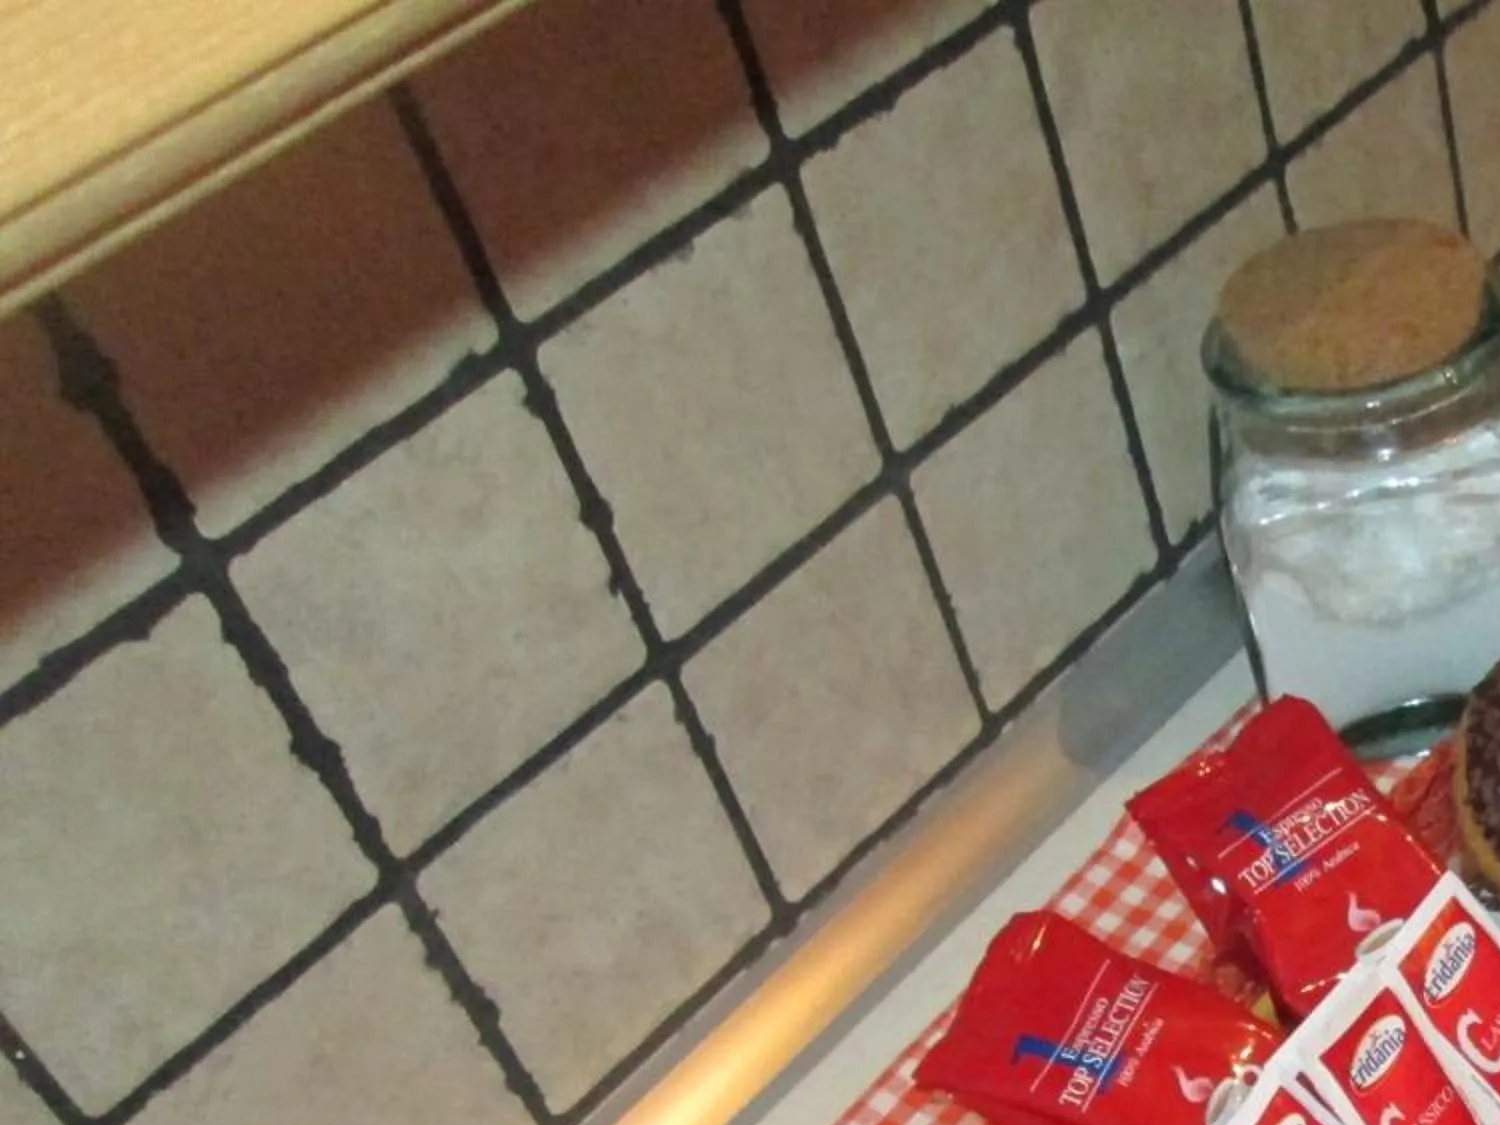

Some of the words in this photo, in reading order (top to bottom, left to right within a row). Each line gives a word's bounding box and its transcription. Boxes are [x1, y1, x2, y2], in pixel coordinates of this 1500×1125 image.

[1238, 847, 1277, 888] TOP
[1274, 787, 1371, 865] SELECTION
[1057, 1066, 1095, 1106] TOP
[1082, 973, 1151, 1069] SELECTION
